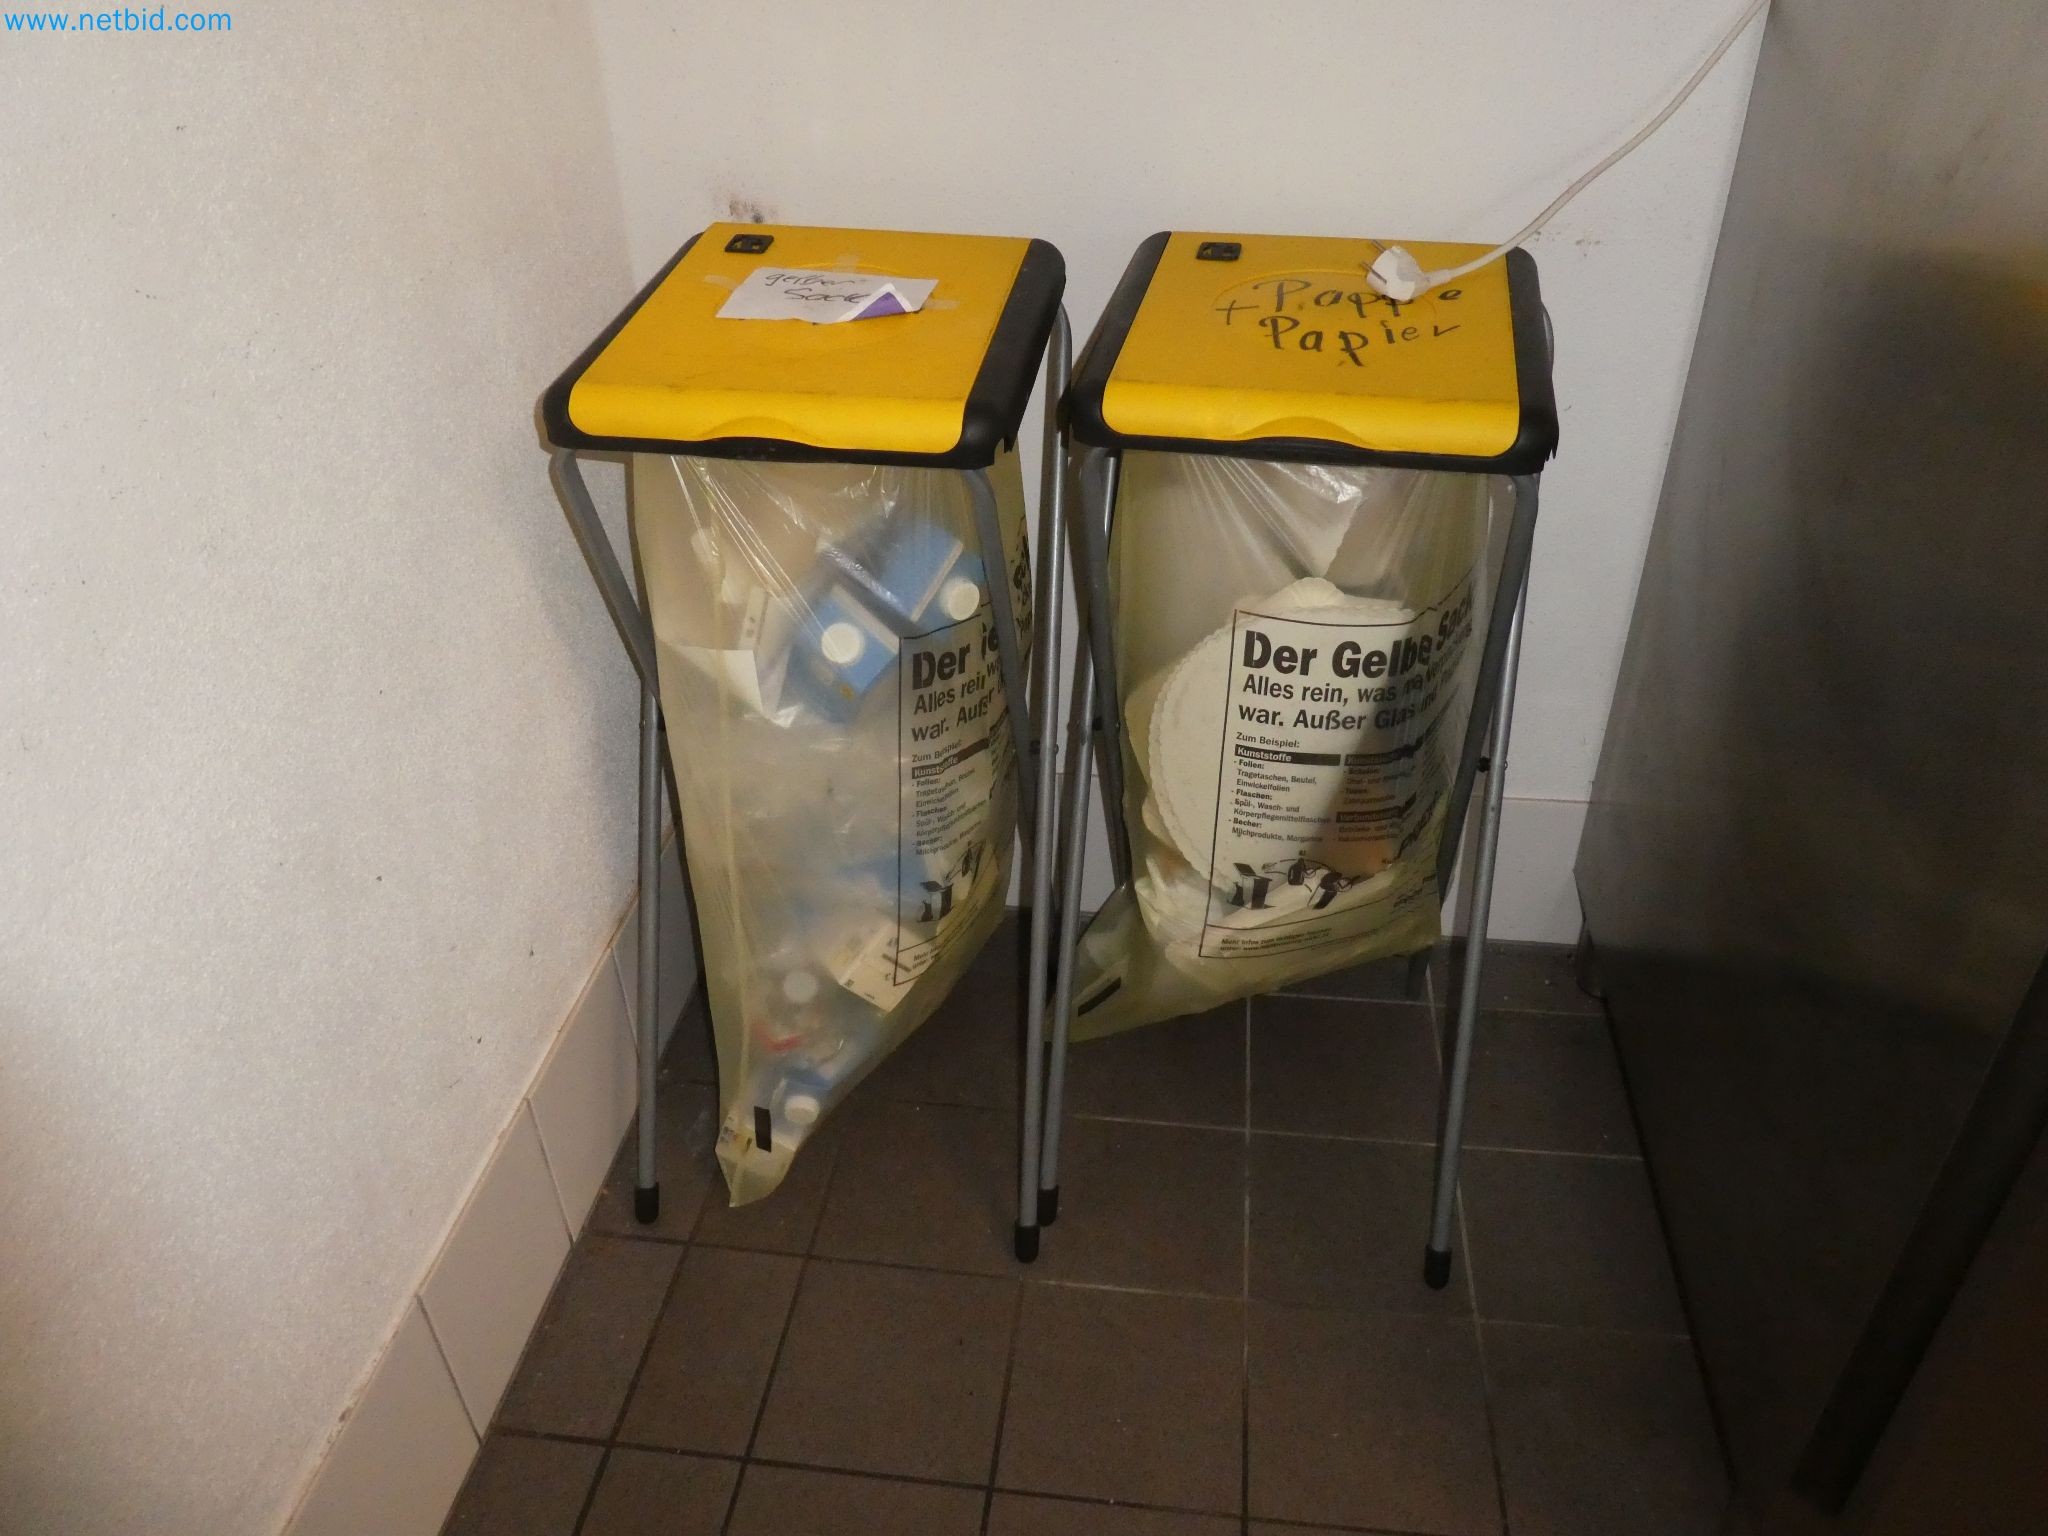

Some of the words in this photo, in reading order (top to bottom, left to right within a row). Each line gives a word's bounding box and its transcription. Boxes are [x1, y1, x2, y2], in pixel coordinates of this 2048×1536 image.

[1258, 314, 1461, 367] Papier
[911, 643, 971, 691] Der
[1242, 629, 1318, 676] Der
[1331, 633, 1433, 679] Gelbe
[913, 688, 956, 716] Alles
[1242, 673, 1295, 701] Alles
[1300, 682, 1350, 706] rein,
[1357, 685, 1398, 704] was
[911, 717, 950, 742] war.
[1238, 703, 1285, 728] war.
[1292, 709, 1368, 731] Außer
[1236, 731, 1257, 743] Zum
[1259, 736, 1300, 749] Beispiel:
[1237, 746, 1292, 763] Kunststoffe
